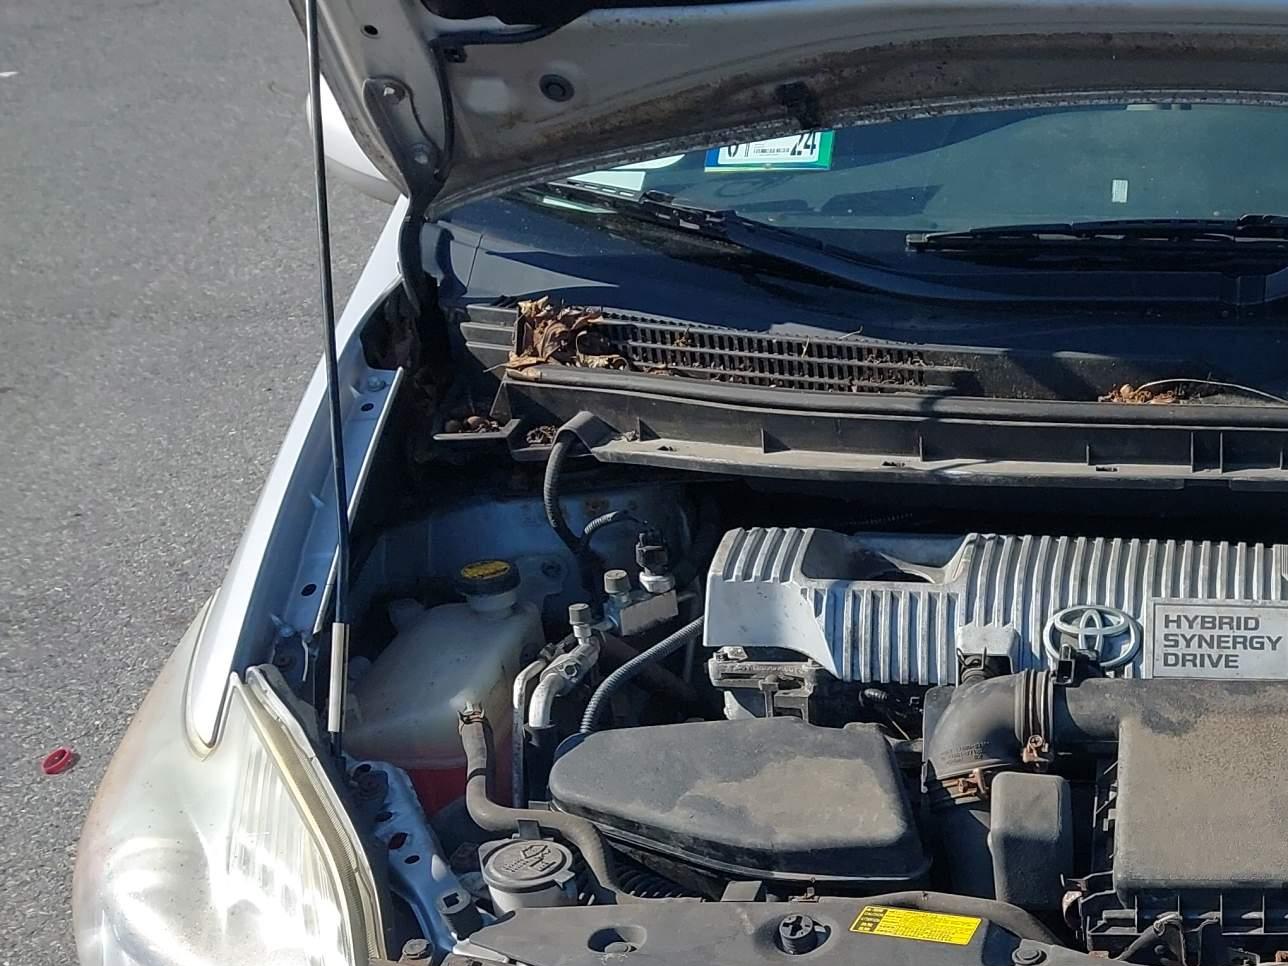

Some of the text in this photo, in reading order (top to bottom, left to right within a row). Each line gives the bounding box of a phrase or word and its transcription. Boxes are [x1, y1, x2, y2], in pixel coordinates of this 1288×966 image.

[1164, 614, 1260, 631] HYBRID
[1163, 633, 1283, 651] SYNERGY
[1163, 652, 1239, 669] DRIVE
